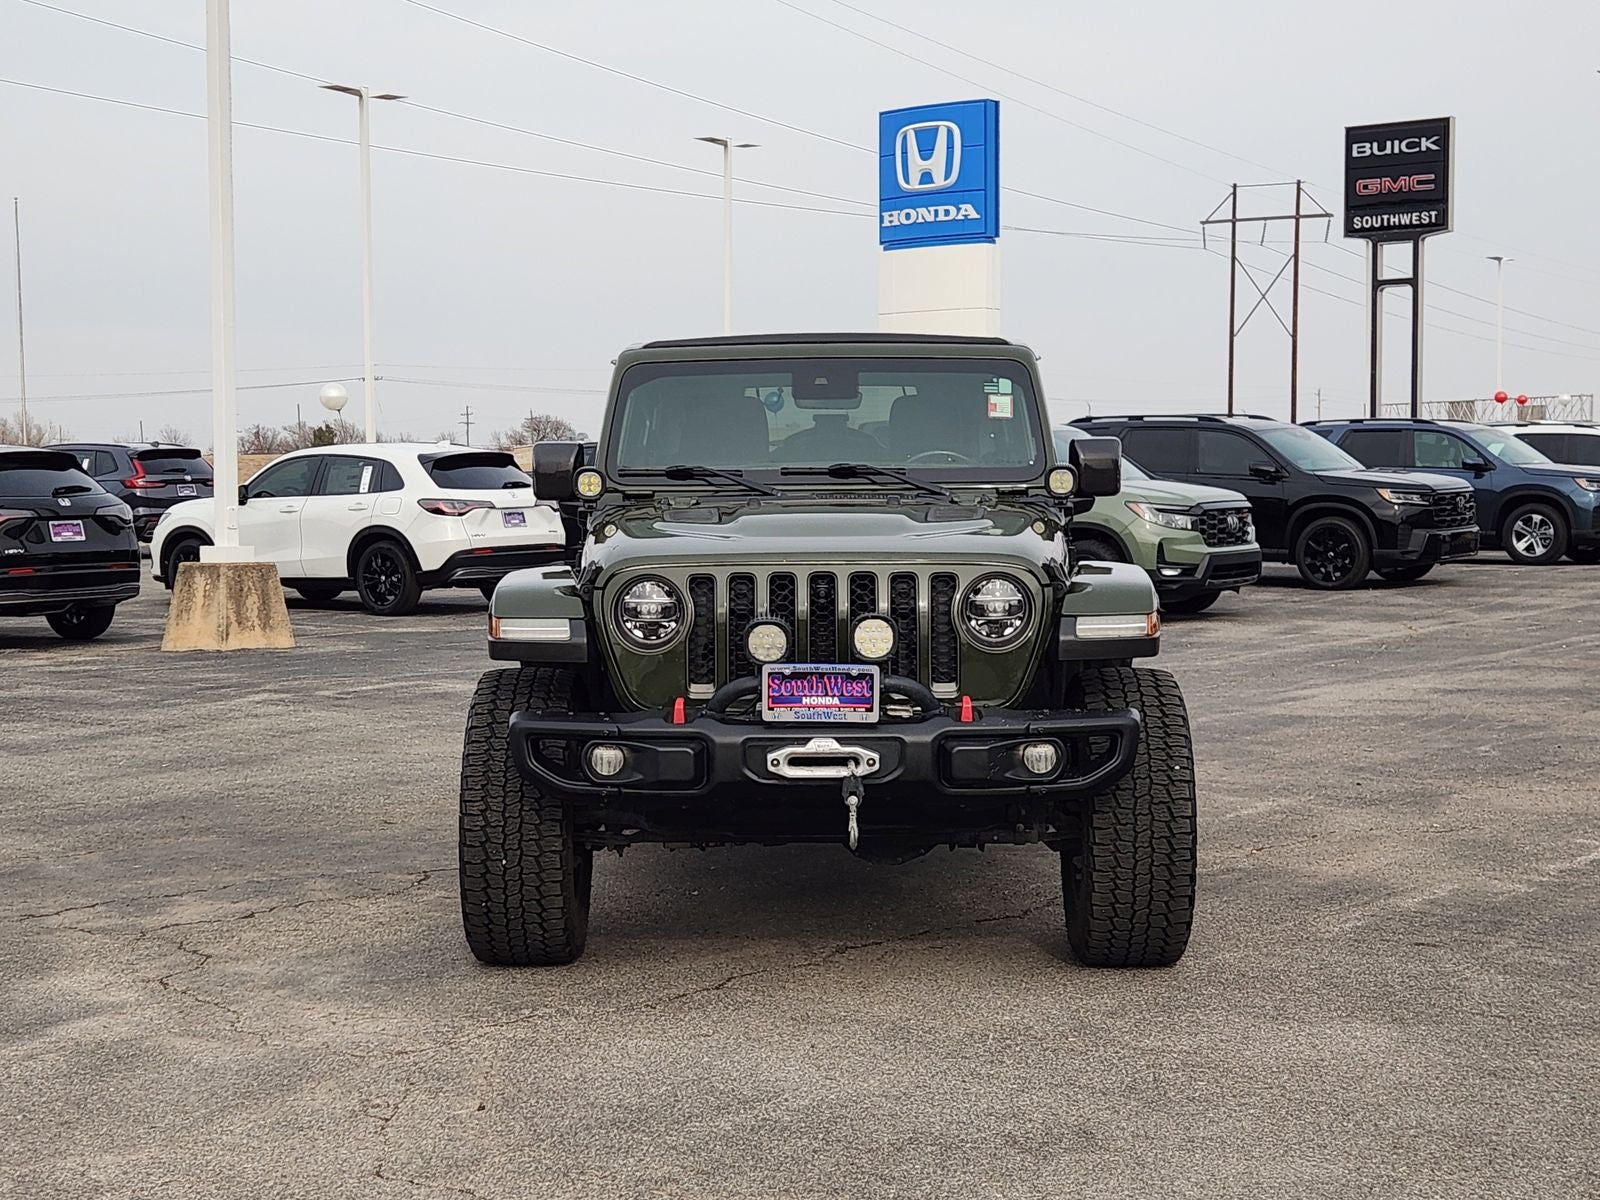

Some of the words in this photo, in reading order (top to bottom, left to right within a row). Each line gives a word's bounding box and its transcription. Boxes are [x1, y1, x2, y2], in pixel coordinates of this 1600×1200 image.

[1351, 135, 1441, 158] BUICK
[1355, 173, 1435, 195] GMC
[881, 203, 981, 227] HONDA
[1352, 210, 1438, 229] SOUTHWEST
[802, 697, 840, 705] HONDA
[794, 711, 848, 720] SouthWest
